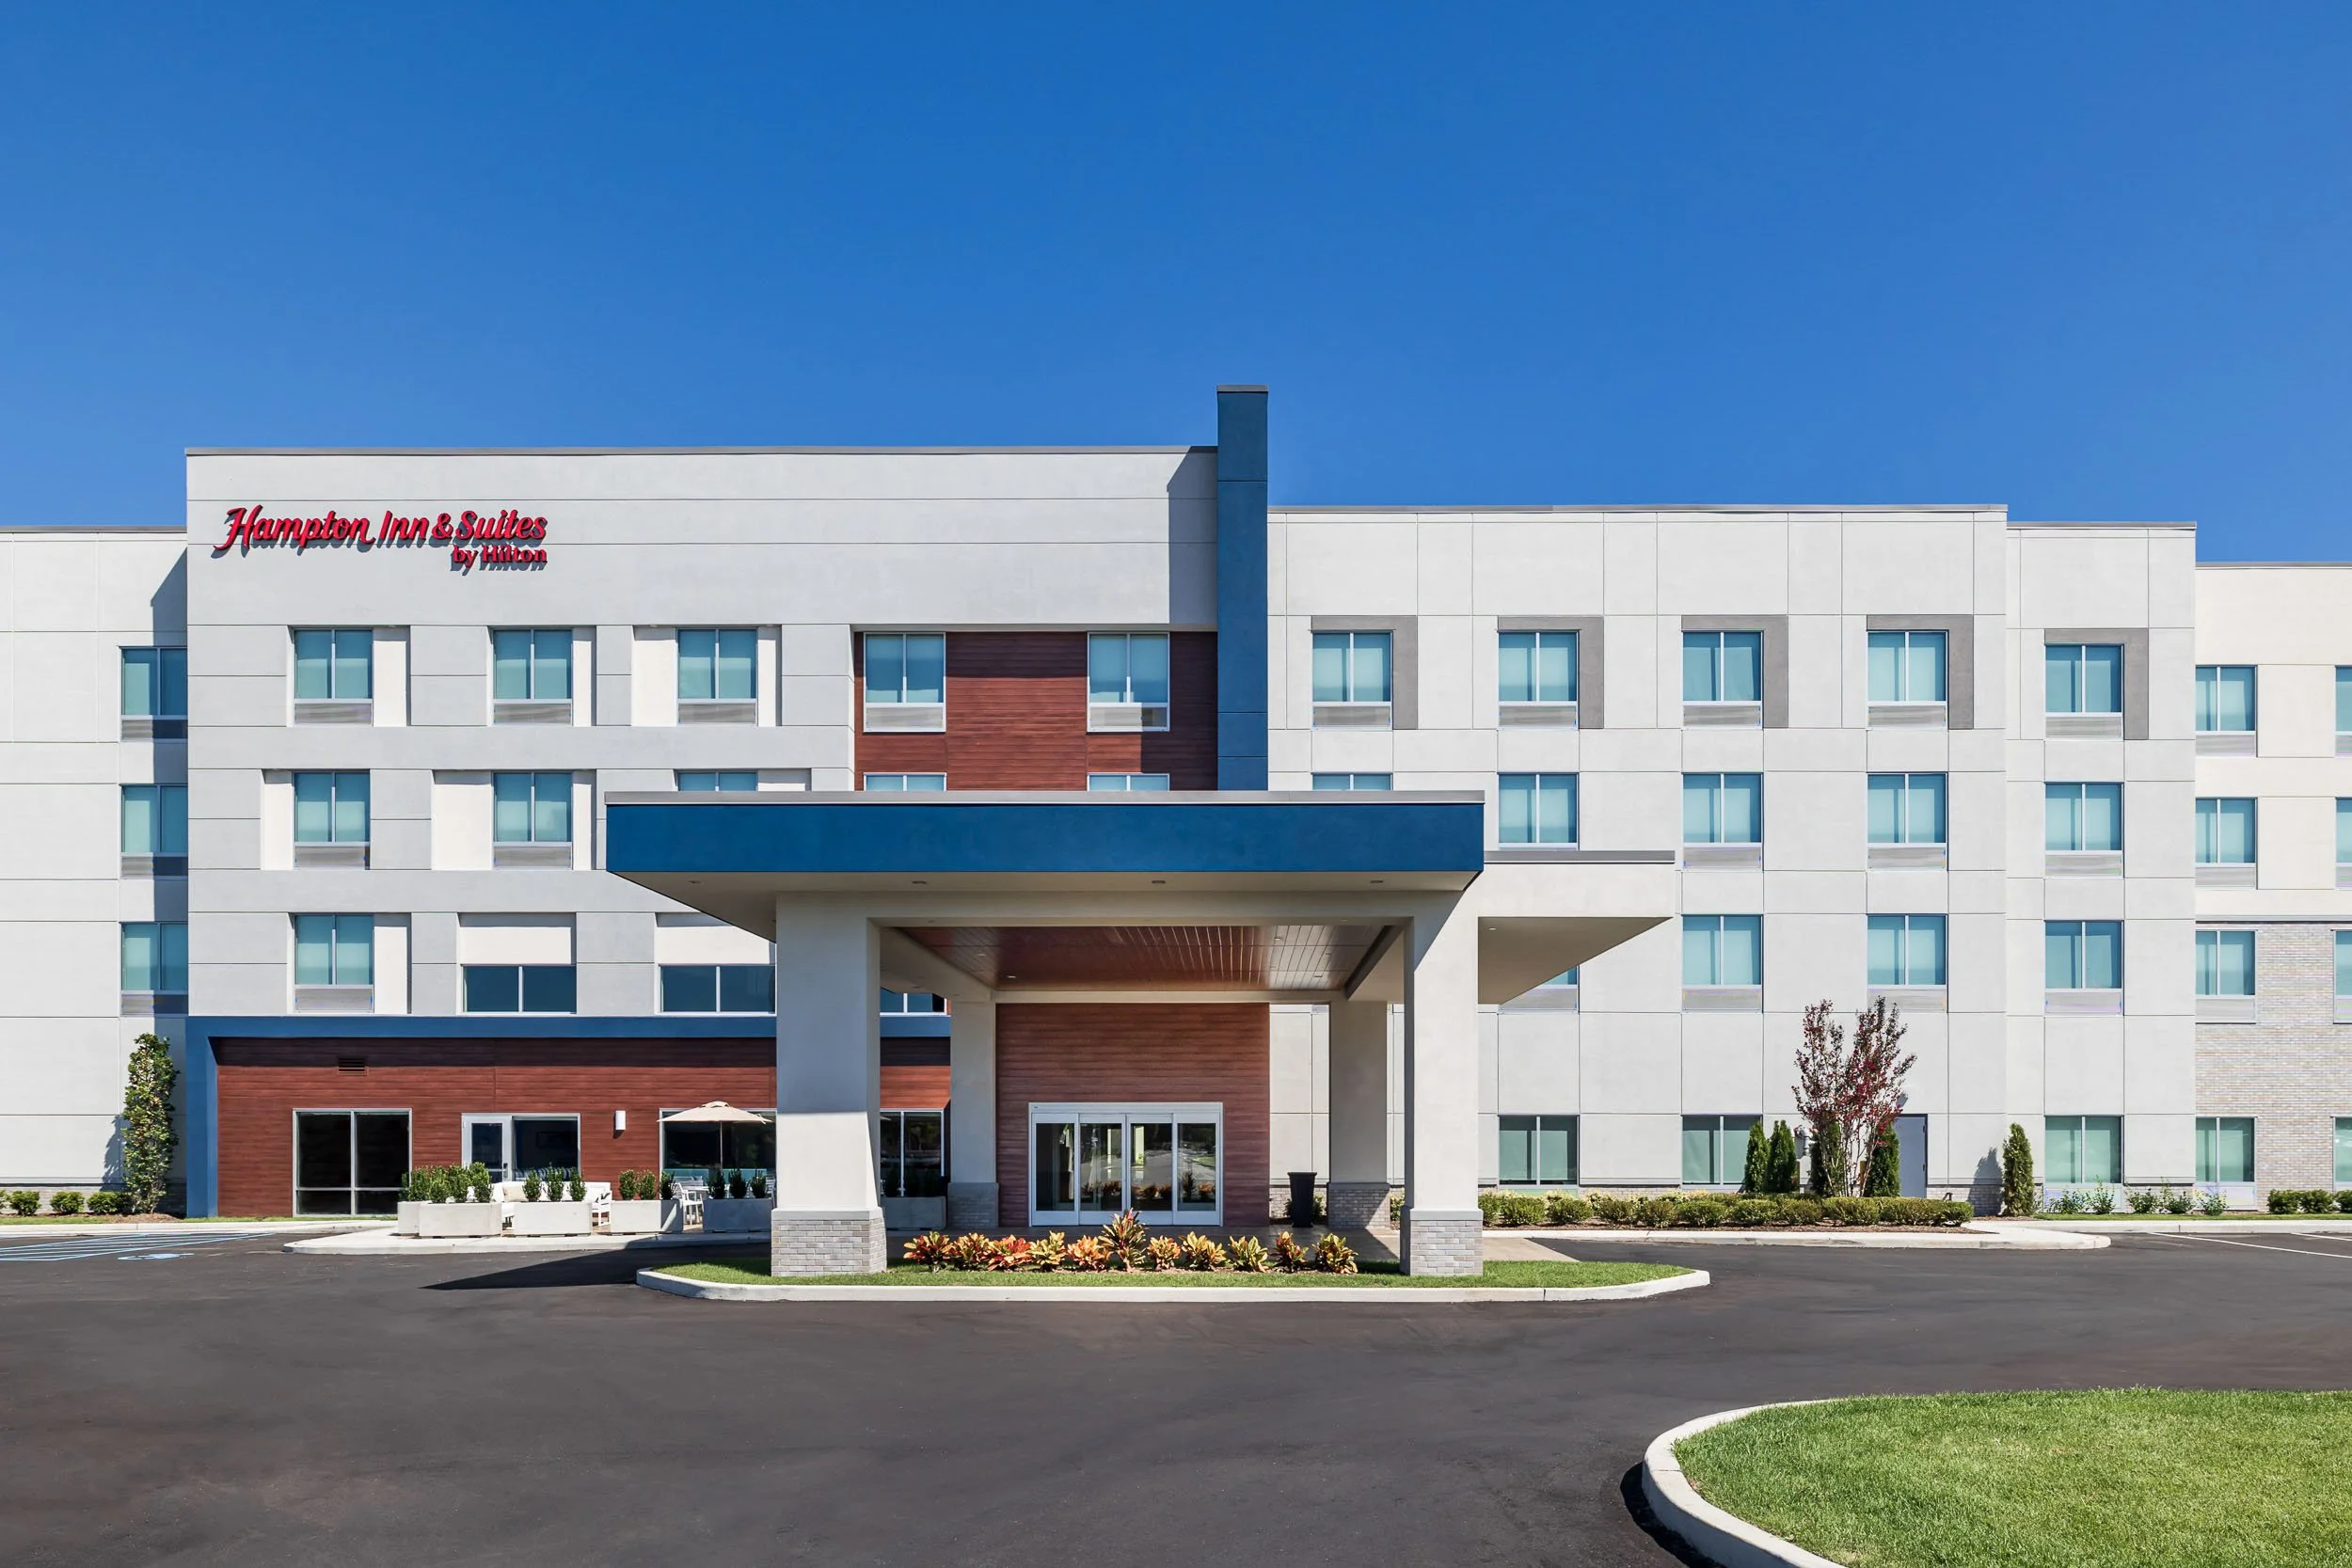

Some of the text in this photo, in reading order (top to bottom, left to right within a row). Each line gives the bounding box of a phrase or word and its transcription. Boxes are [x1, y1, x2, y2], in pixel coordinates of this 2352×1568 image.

[214, 504, 548, 550] Hampton Inn & Suites
[453, 544, 548, 568] by Hilton
